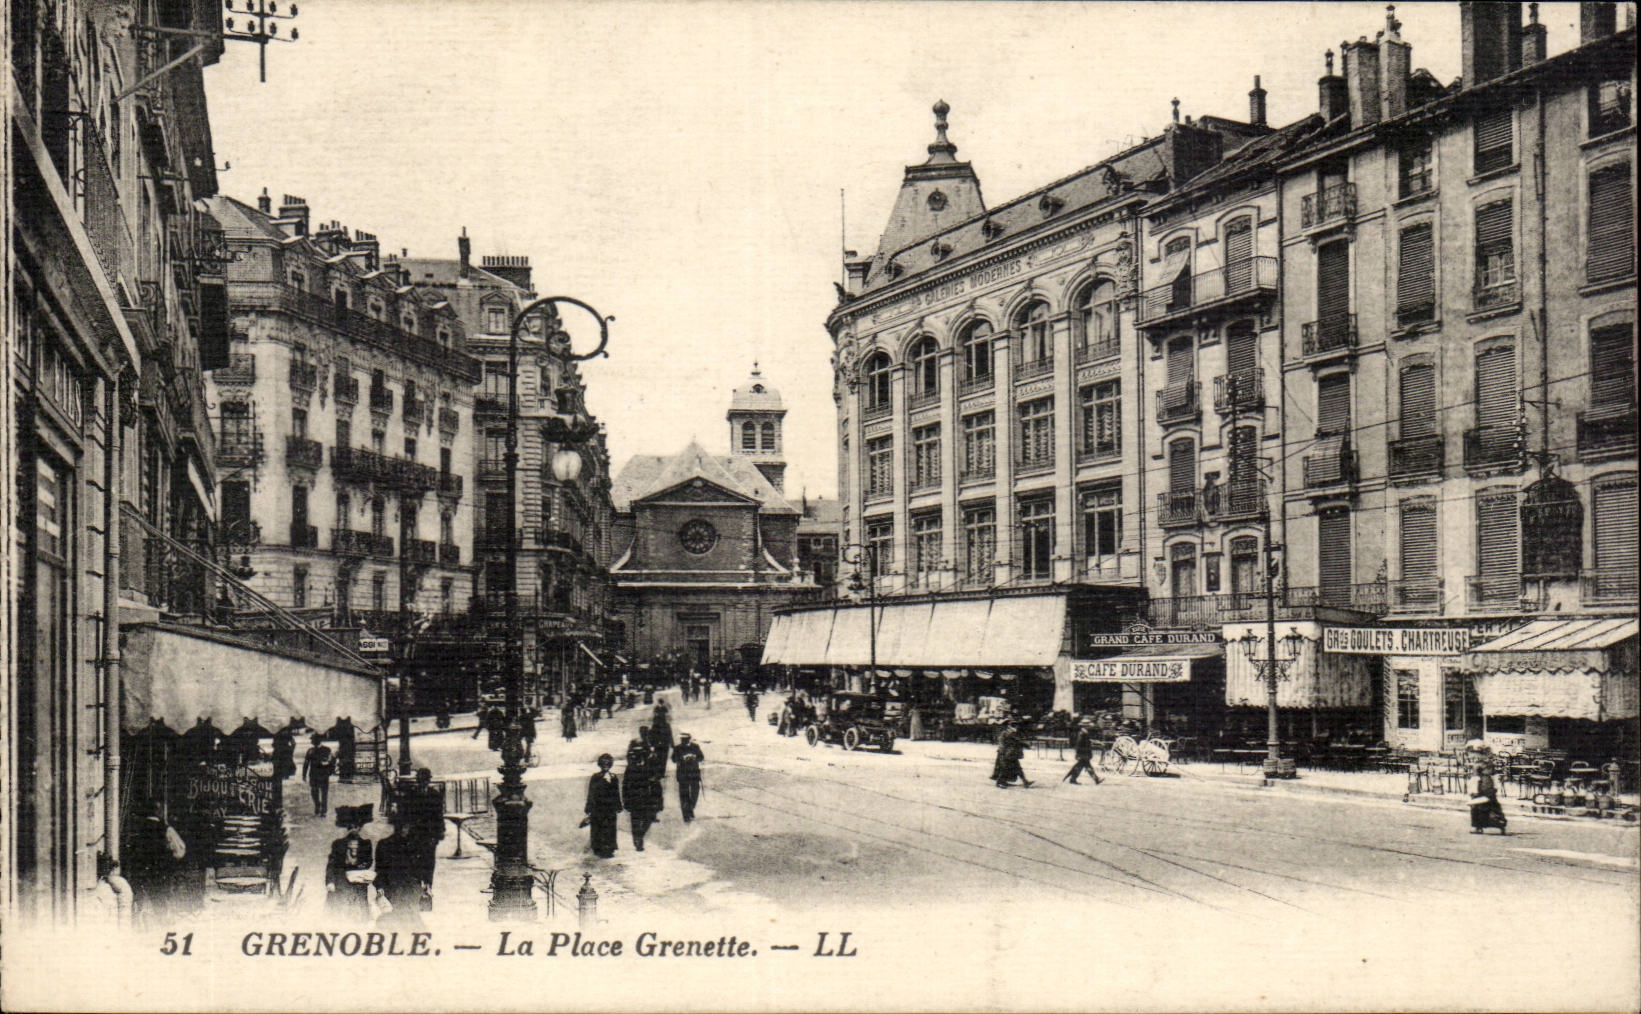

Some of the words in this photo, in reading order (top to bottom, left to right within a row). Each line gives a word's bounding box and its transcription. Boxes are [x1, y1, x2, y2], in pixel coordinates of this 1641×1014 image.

[969, 259, 1022, 290] MODERNES
[1093, 635, 1129, 645] GRAND
[1133, 635, 1163, 644] CAFE
[1167, 633, 1216, 643] DURAND
[1401, 629, 1468, 653] CHARTREUSE
[1087, 663, 1117, 677] CAFE
[1121, 663, 1169, 677] DURAND
